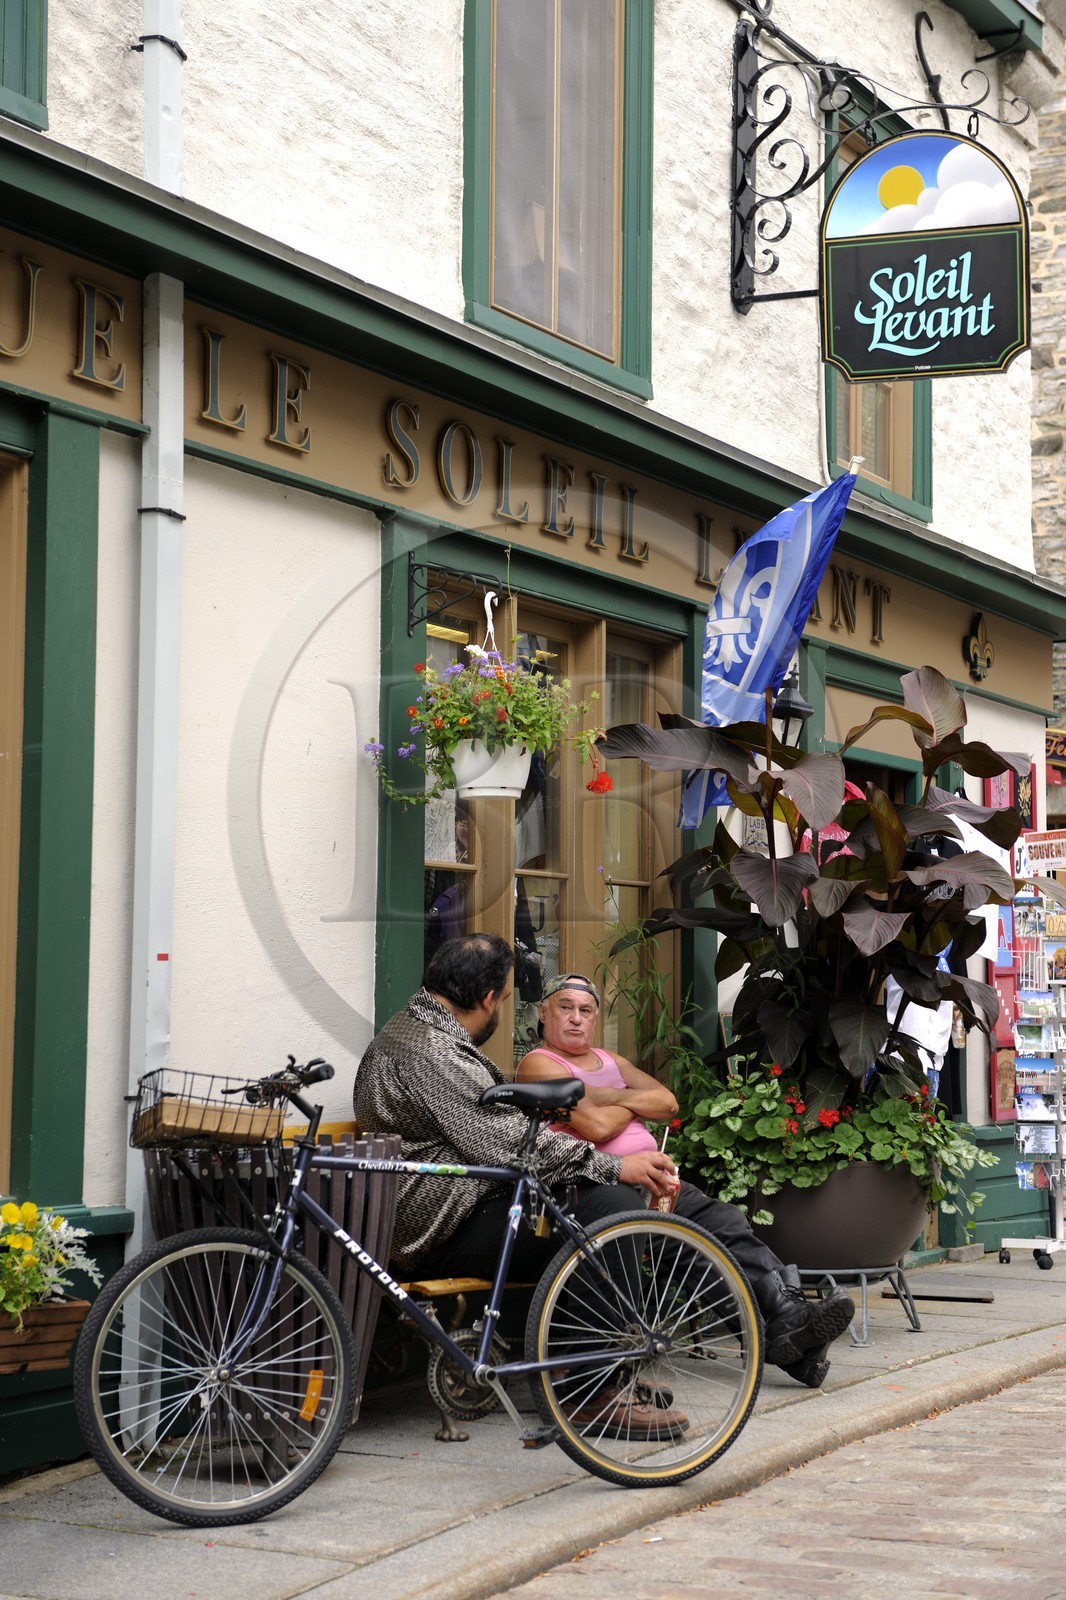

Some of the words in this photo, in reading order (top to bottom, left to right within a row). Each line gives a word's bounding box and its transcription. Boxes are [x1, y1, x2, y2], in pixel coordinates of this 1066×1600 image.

[864, 251, 974, 312] Soleil
[854, 293, 995, 357] Levant
[201, 327, 311, 455] LE
[383, 400, 650, 564] SOLEIL
[695, 512, 891, 643] LNT
[334, 1228, 409, 1301] PROTOUR
